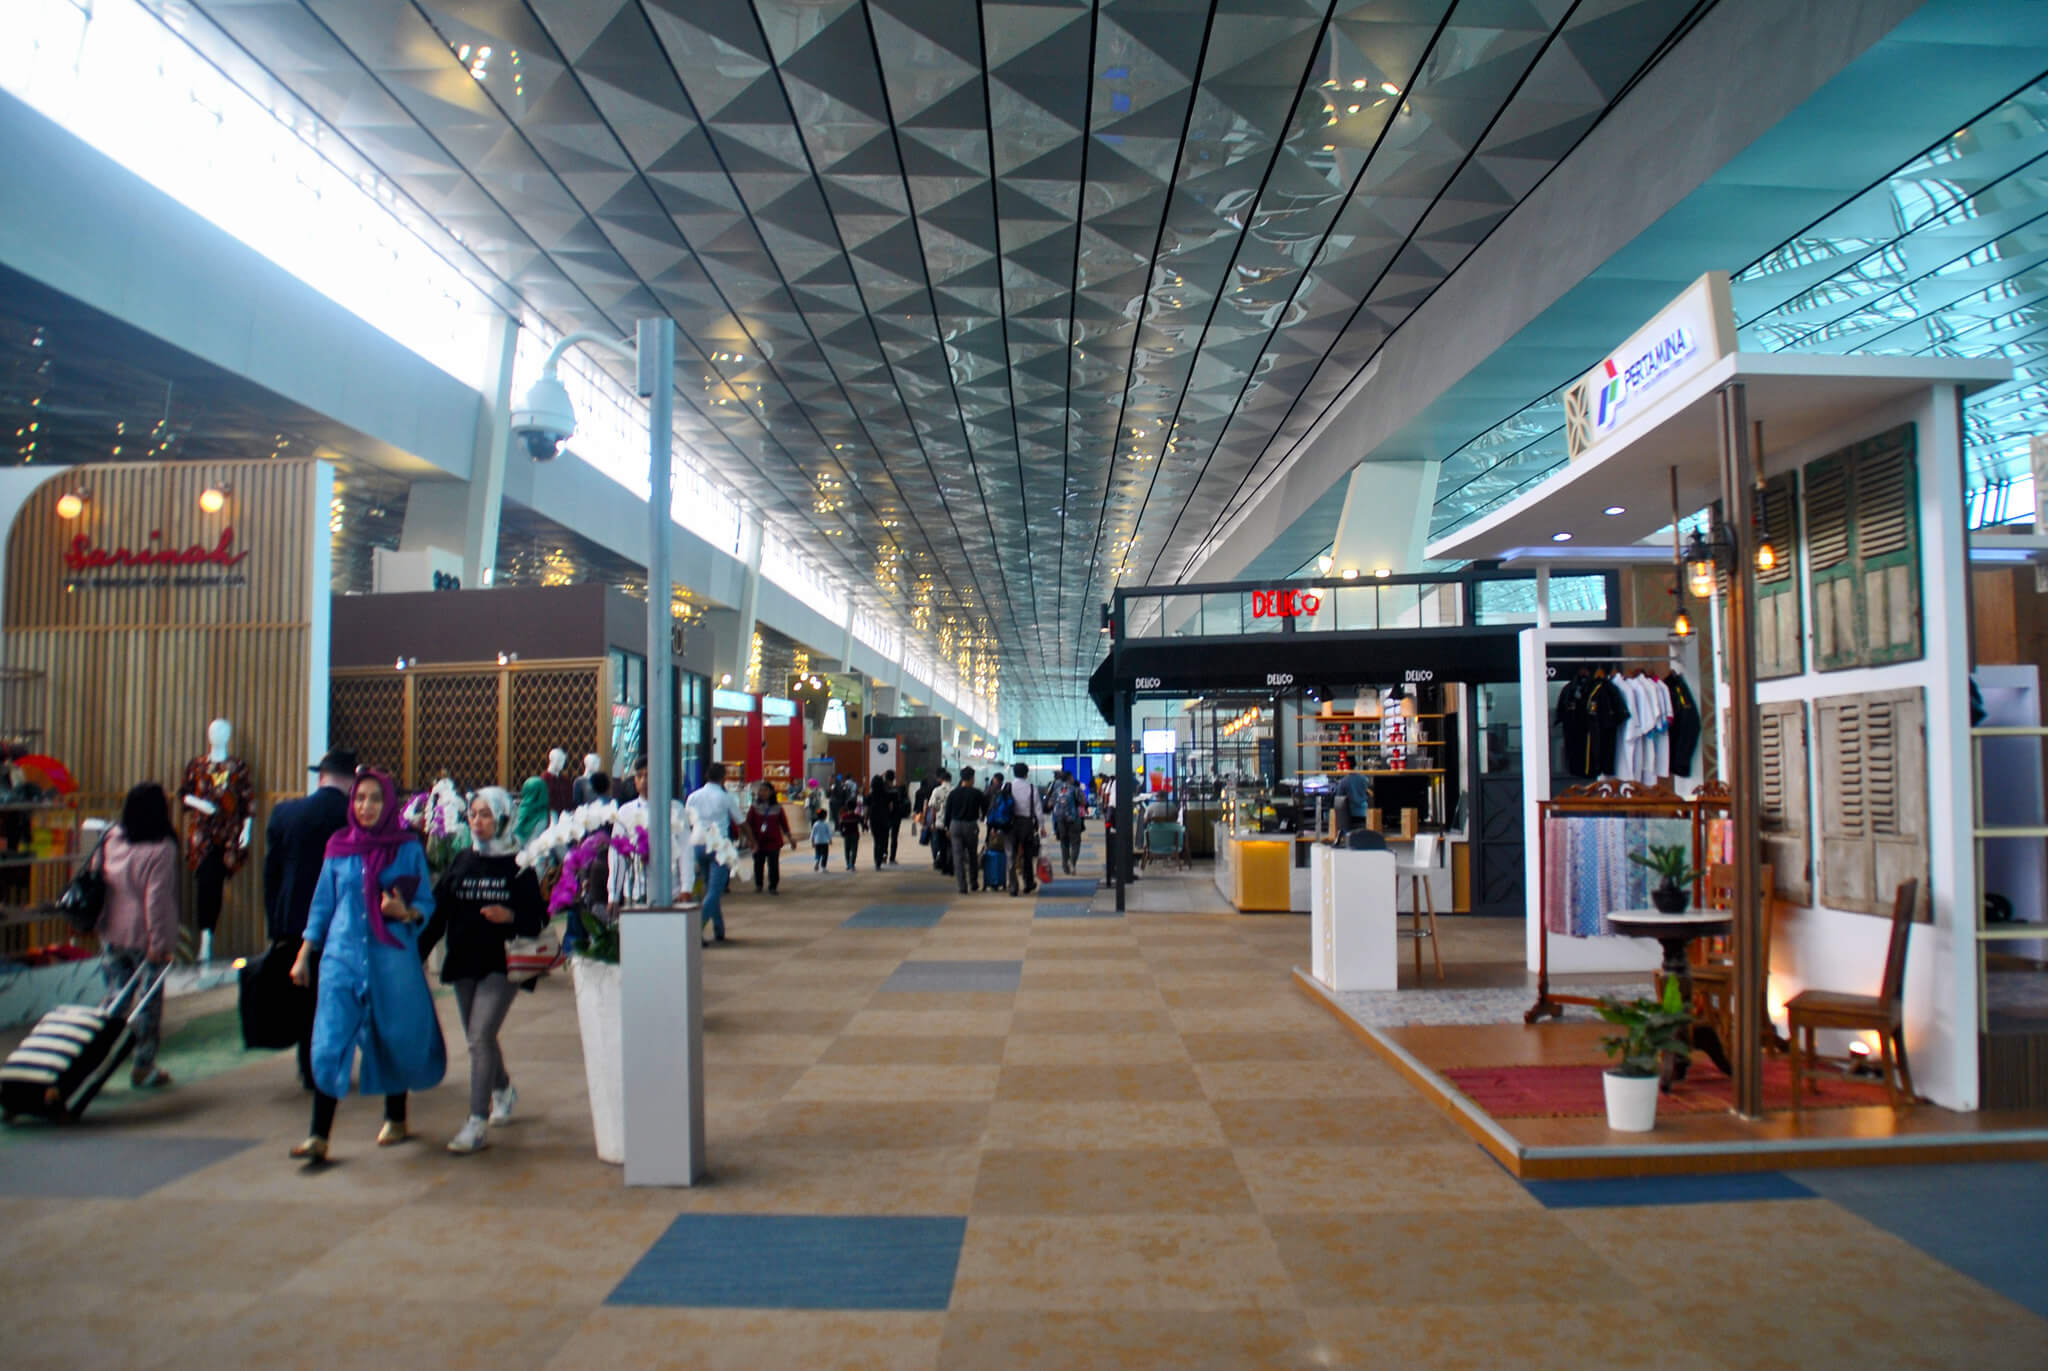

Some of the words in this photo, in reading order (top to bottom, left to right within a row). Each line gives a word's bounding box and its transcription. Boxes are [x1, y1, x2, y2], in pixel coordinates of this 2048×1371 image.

[1624, 327, 1686, 386] PERTAMINA
[64, 526, 248, 572] Sarinah
[1252, 588, 1320, 618] DELICO
[1135, 677, 1161, 689] DELICO
[1266, 673, 1294, 686] DELICO
[1404, 669, 1433, 682] DELICO
